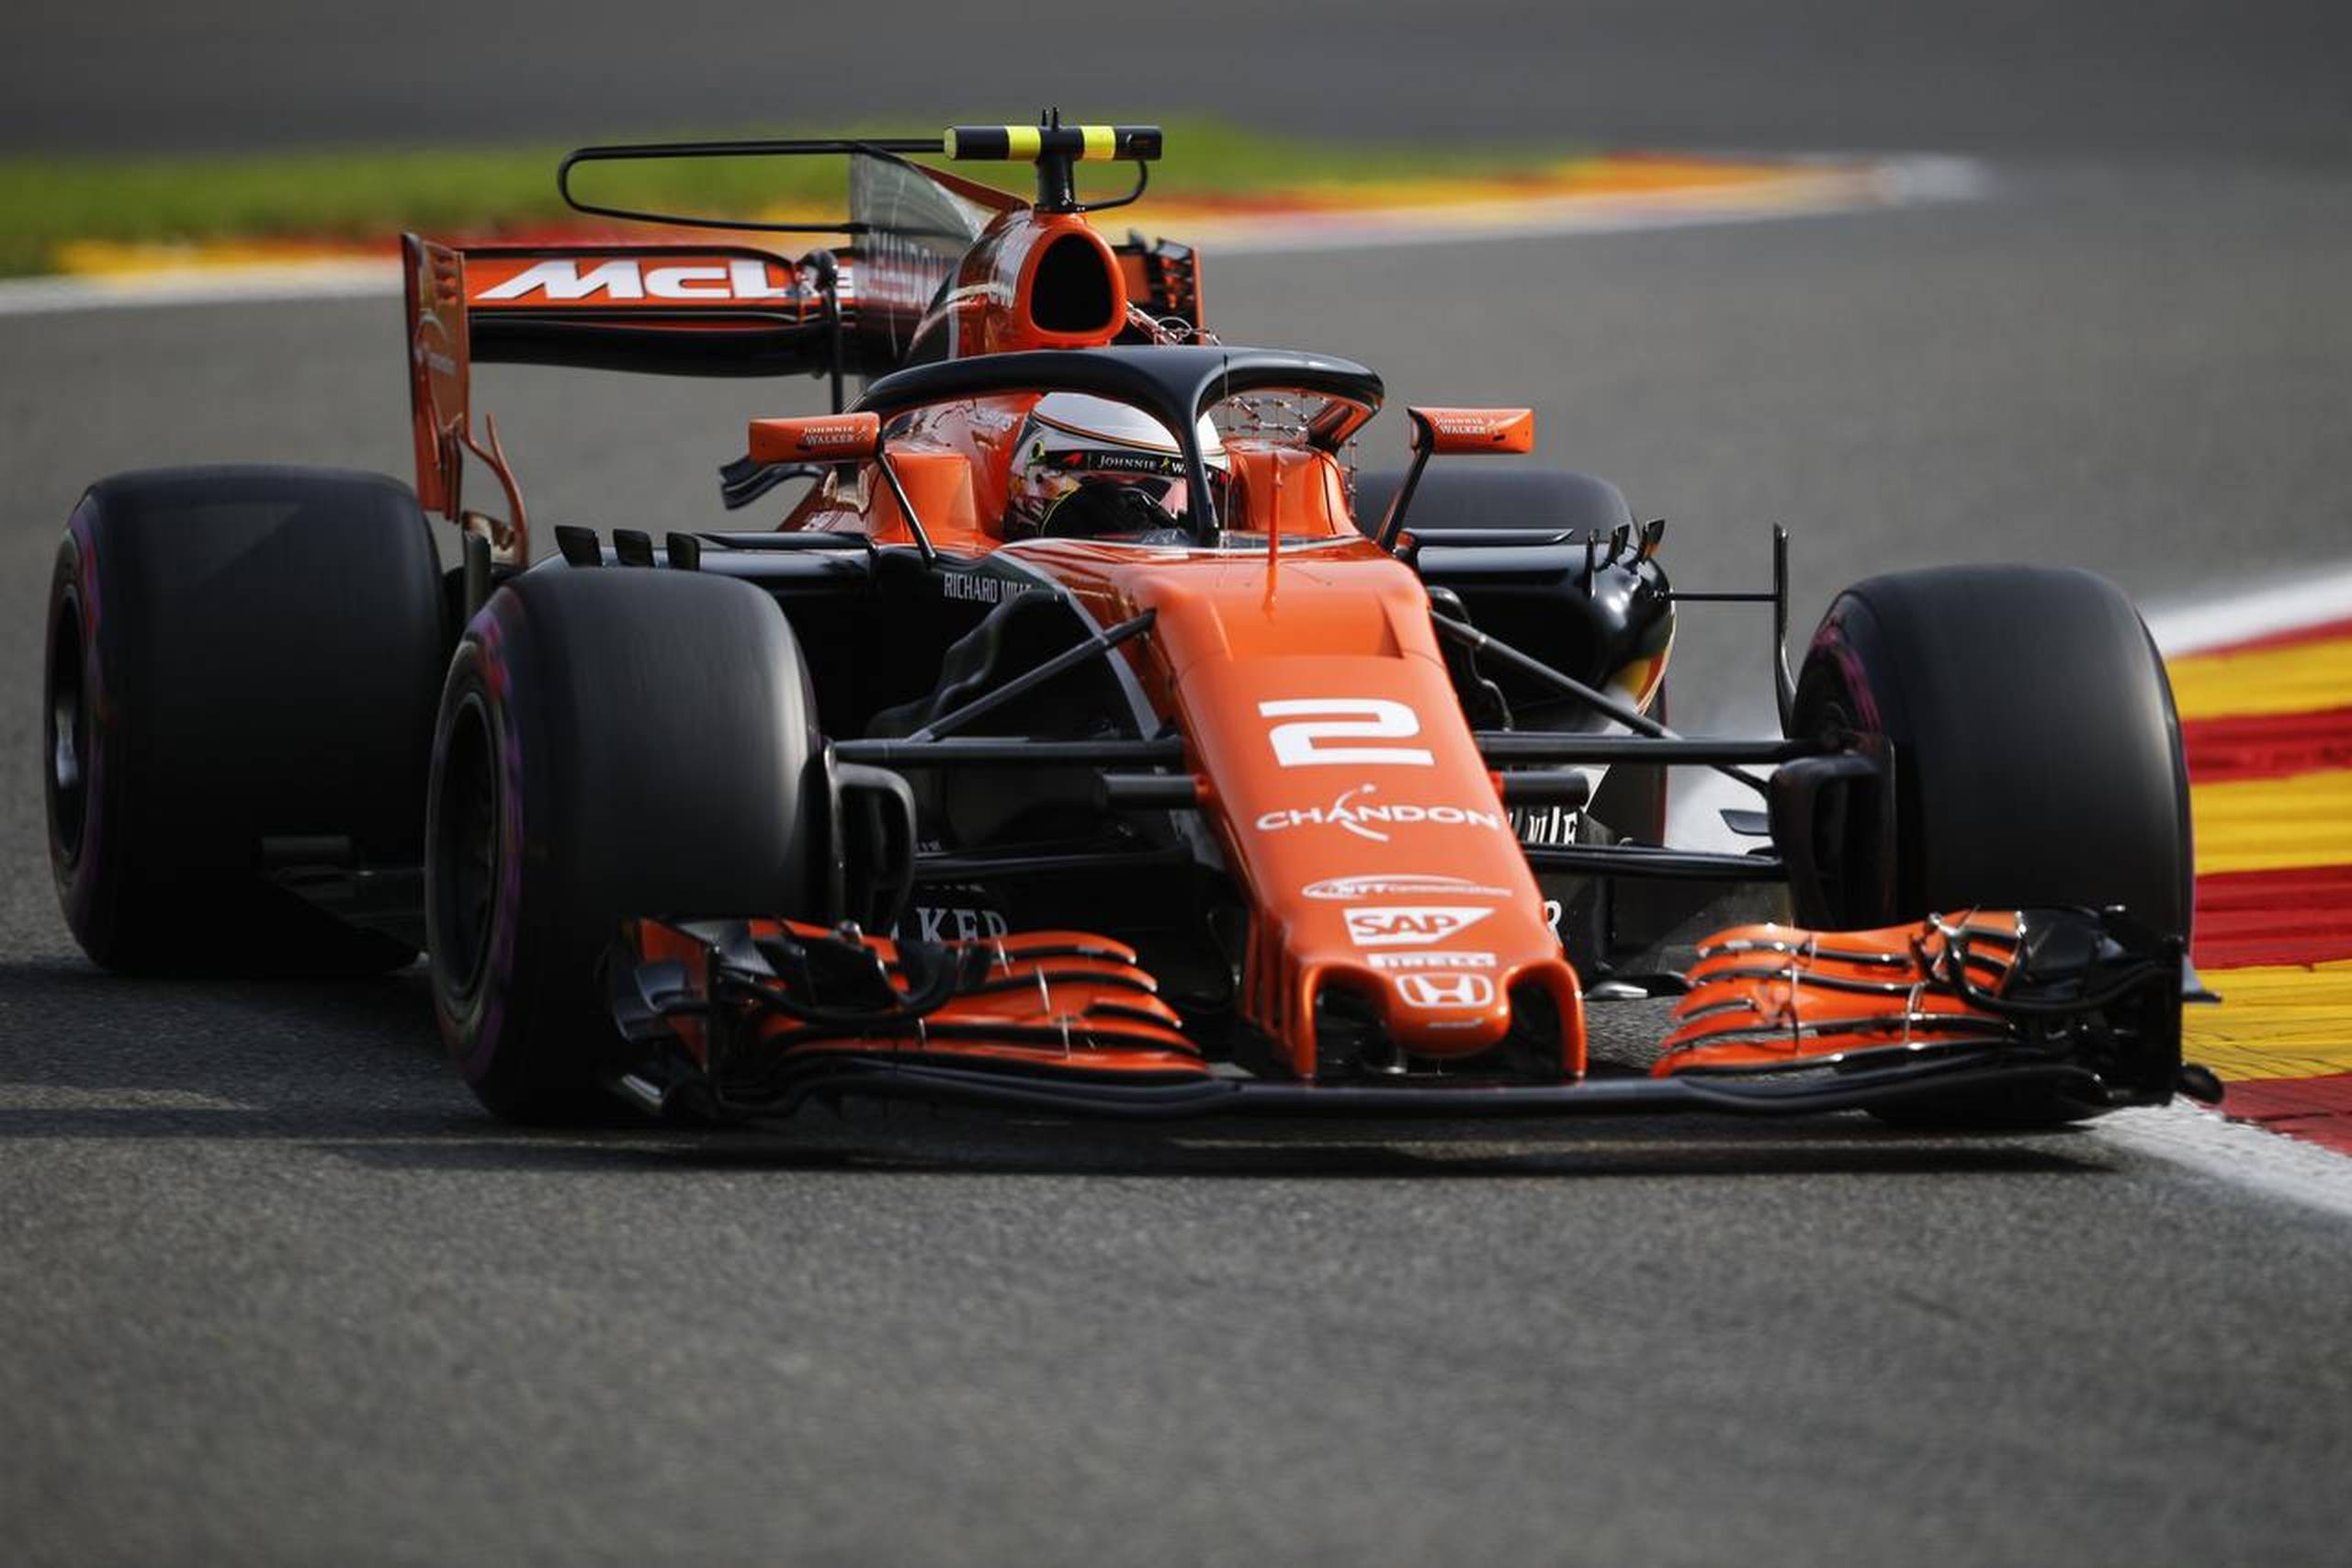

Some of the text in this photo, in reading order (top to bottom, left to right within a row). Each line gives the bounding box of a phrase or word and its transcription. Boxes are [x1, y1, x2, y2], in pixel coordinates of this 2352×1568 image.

[944, 572, 999, 604] RICHARD
[1257, 698, 1435, 767] 2
[1256, 797, 1501, 834] CHANDON
[1351, 914, 1460, 937] SAP
